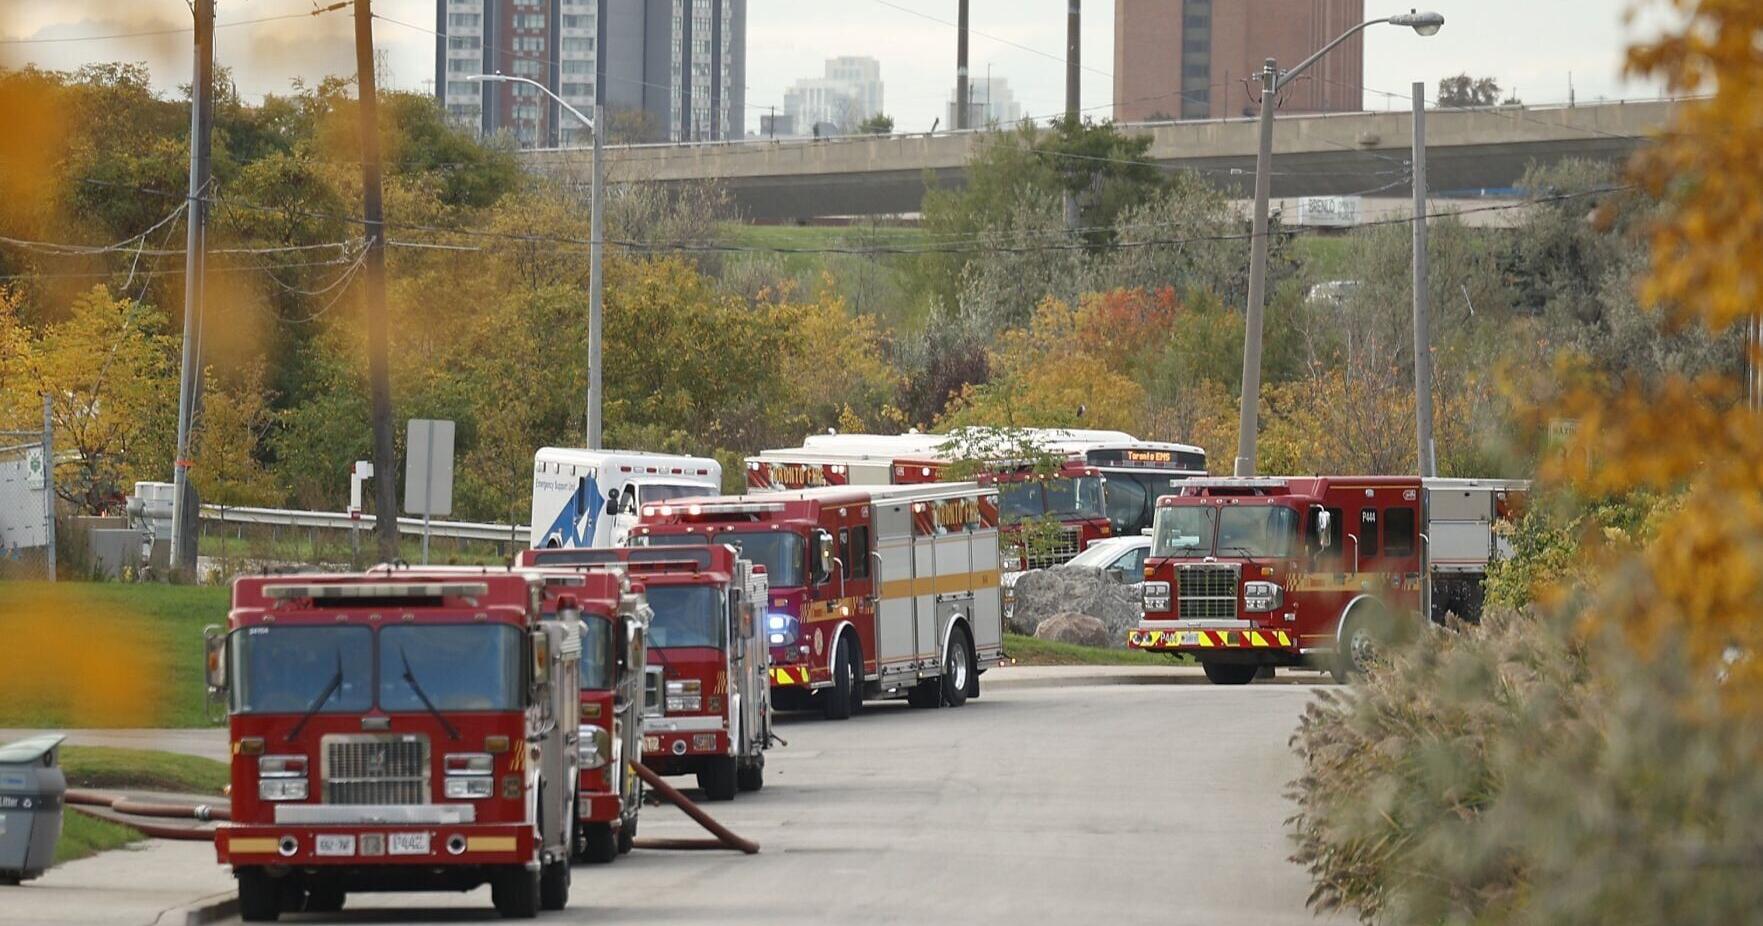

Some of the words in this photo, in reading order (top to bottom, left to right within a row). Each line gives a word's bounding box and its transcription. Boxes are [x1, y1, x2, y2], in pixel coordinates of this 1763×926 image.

[1308, 198, 1335, 213] BRENLO
[1128, 451, 1155, 461] Toronto
[1155, 452, 1171, 461] EMS
[1362, 511, 1376, 523] P444
